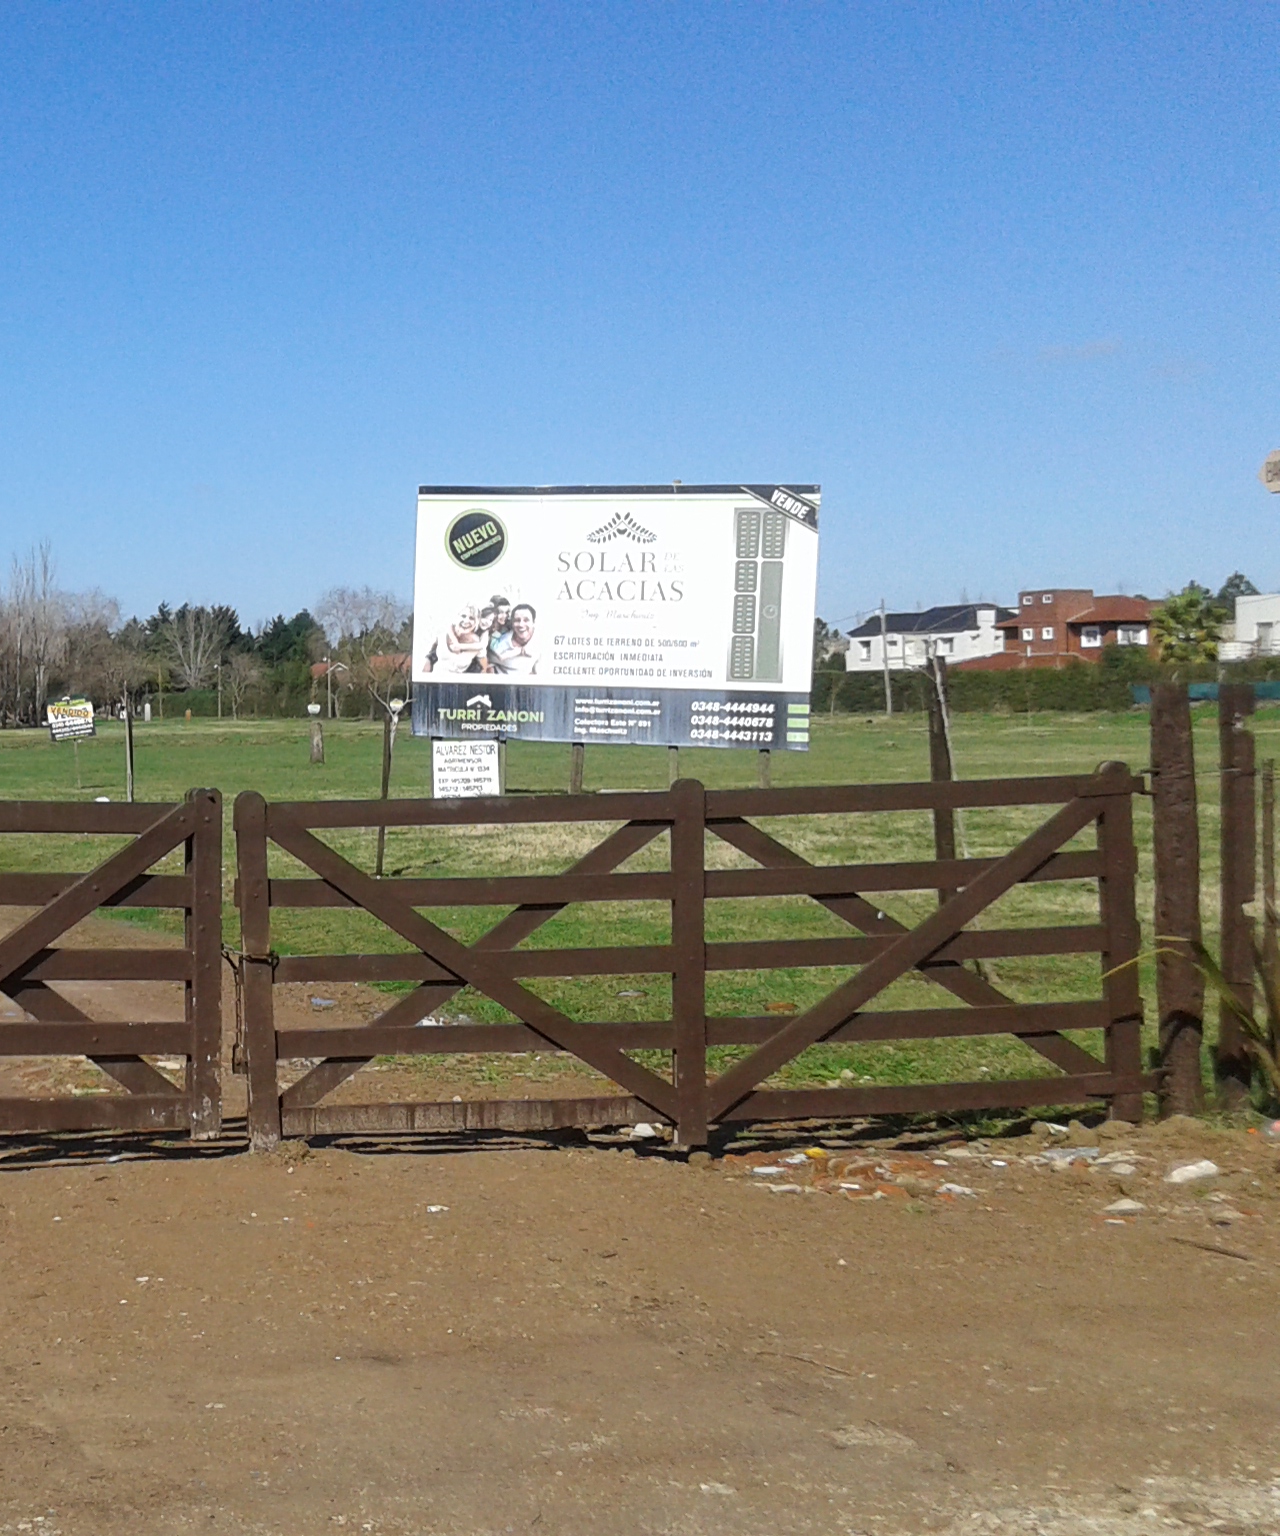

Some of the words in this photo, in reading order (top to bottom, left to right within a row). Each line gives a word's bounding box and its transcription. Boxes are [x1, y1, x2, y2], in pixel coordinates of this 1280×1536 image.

[771, 489, 810, 519] VENDE
[453, 521, 497, 554] NUEVO
[558, 551, 657, 573] SOLAR
[557, 580, 684, 602] ACACIAS
[554, 636, 565, 646] 67
[567, 637, 591, 646] LOTES
[594, 637, 603, 646] DE
[606, 638, 642, 647] TERRENO
[645, 638, 655, 647] DE
[620, 653, 663, 662] INMEDIATA
[553, 666, 595, 675] EXCELENTE
[598, 667, 654, 677] OPORTUNIDAD
[657, 668, 666, 677] DE
[691, 701, 775, 714] 0348-4444944
[487, 710, 544, 723] ZANONI
[690, 715, 774, 728] 0348-4440678
[461, 723, 517, 732] PROPIEDADES
[690, 729, 773, 742] 0348-4443113
[436, 745, 467, 756] ALVAREZ
[470, 744, 496, 755] NESTOR
